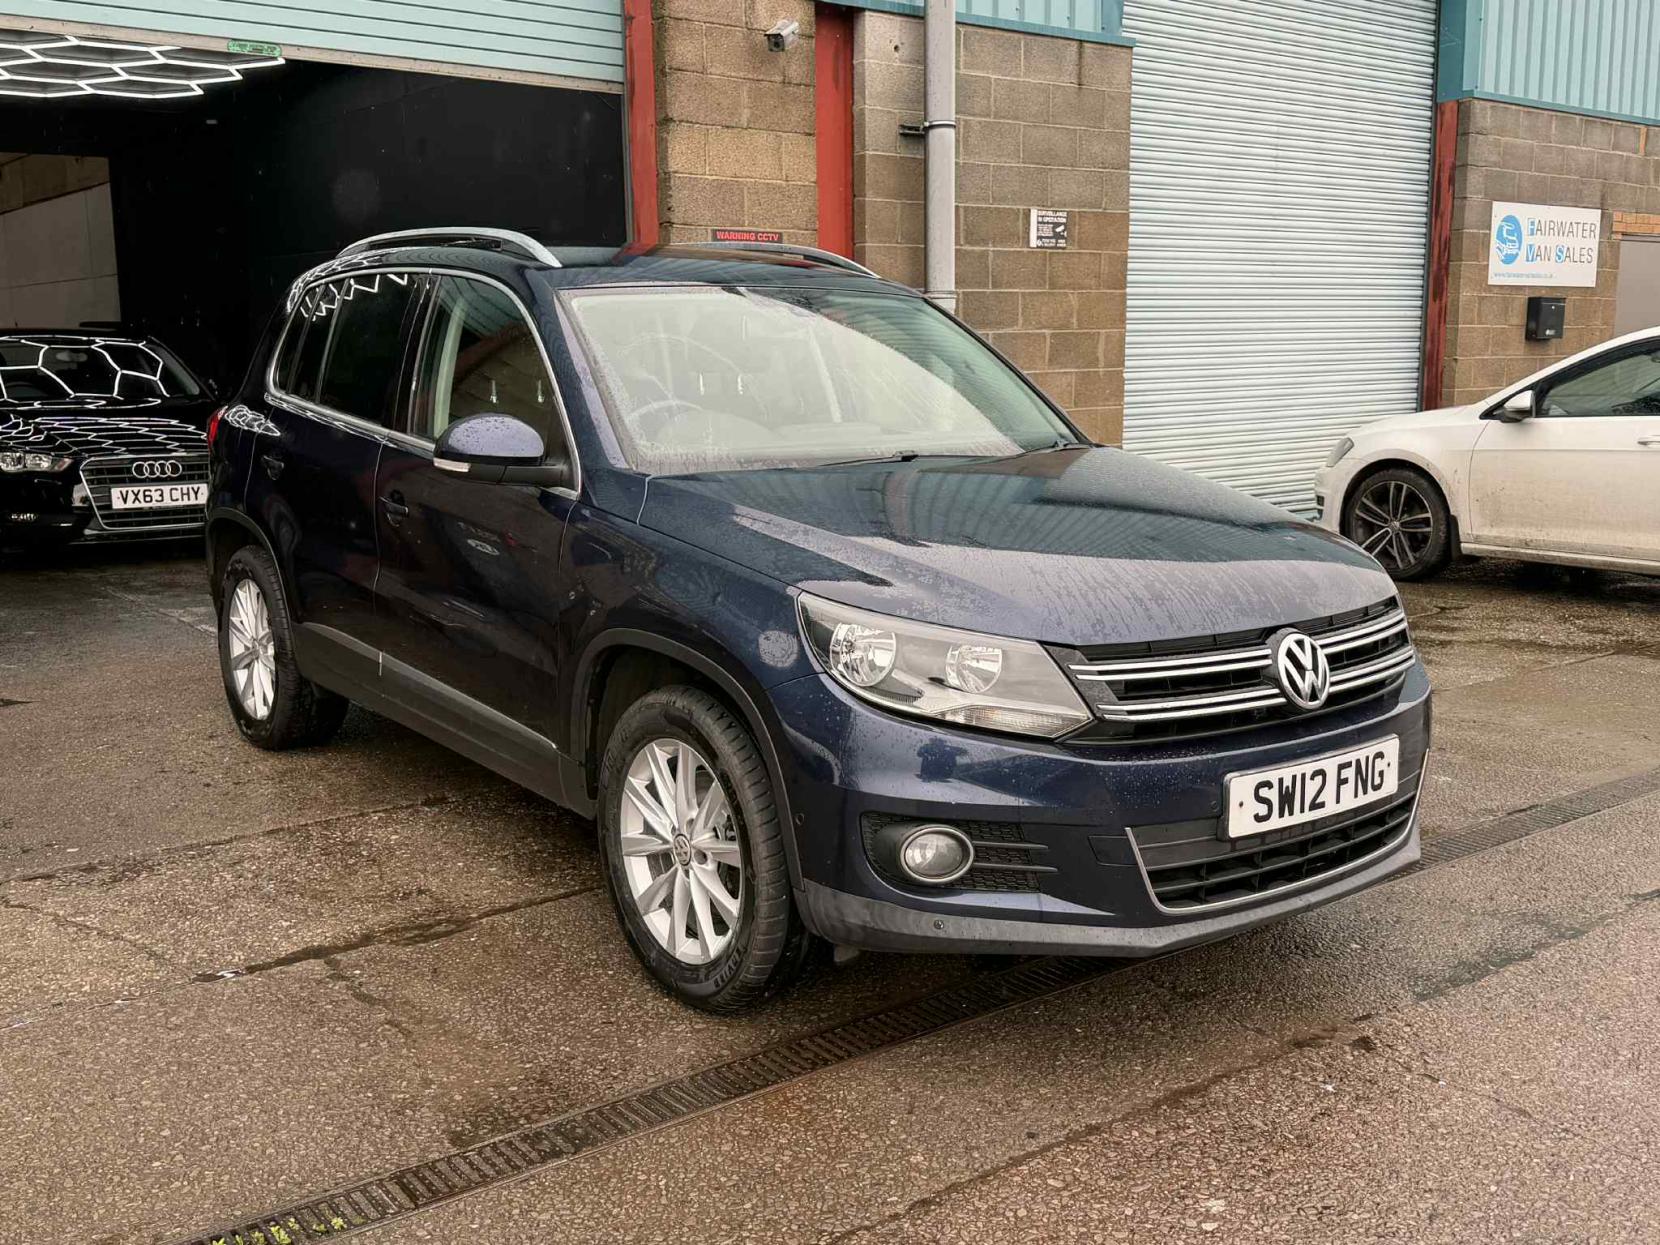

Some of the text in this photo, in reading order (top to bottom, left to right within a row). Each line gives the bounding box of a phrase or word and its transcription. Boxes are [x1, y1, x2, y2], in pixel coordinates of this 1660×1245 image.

[716, 231, 779, 241] WARNING CCTV
[1527, 217, 1597, 239] FAIRWATER
[1525, 243, 1594, 264] VAN SALES
[119, 486, 201, 505] VX63 CHY
[1253, 751, 1385, 823] SW12 FNG
